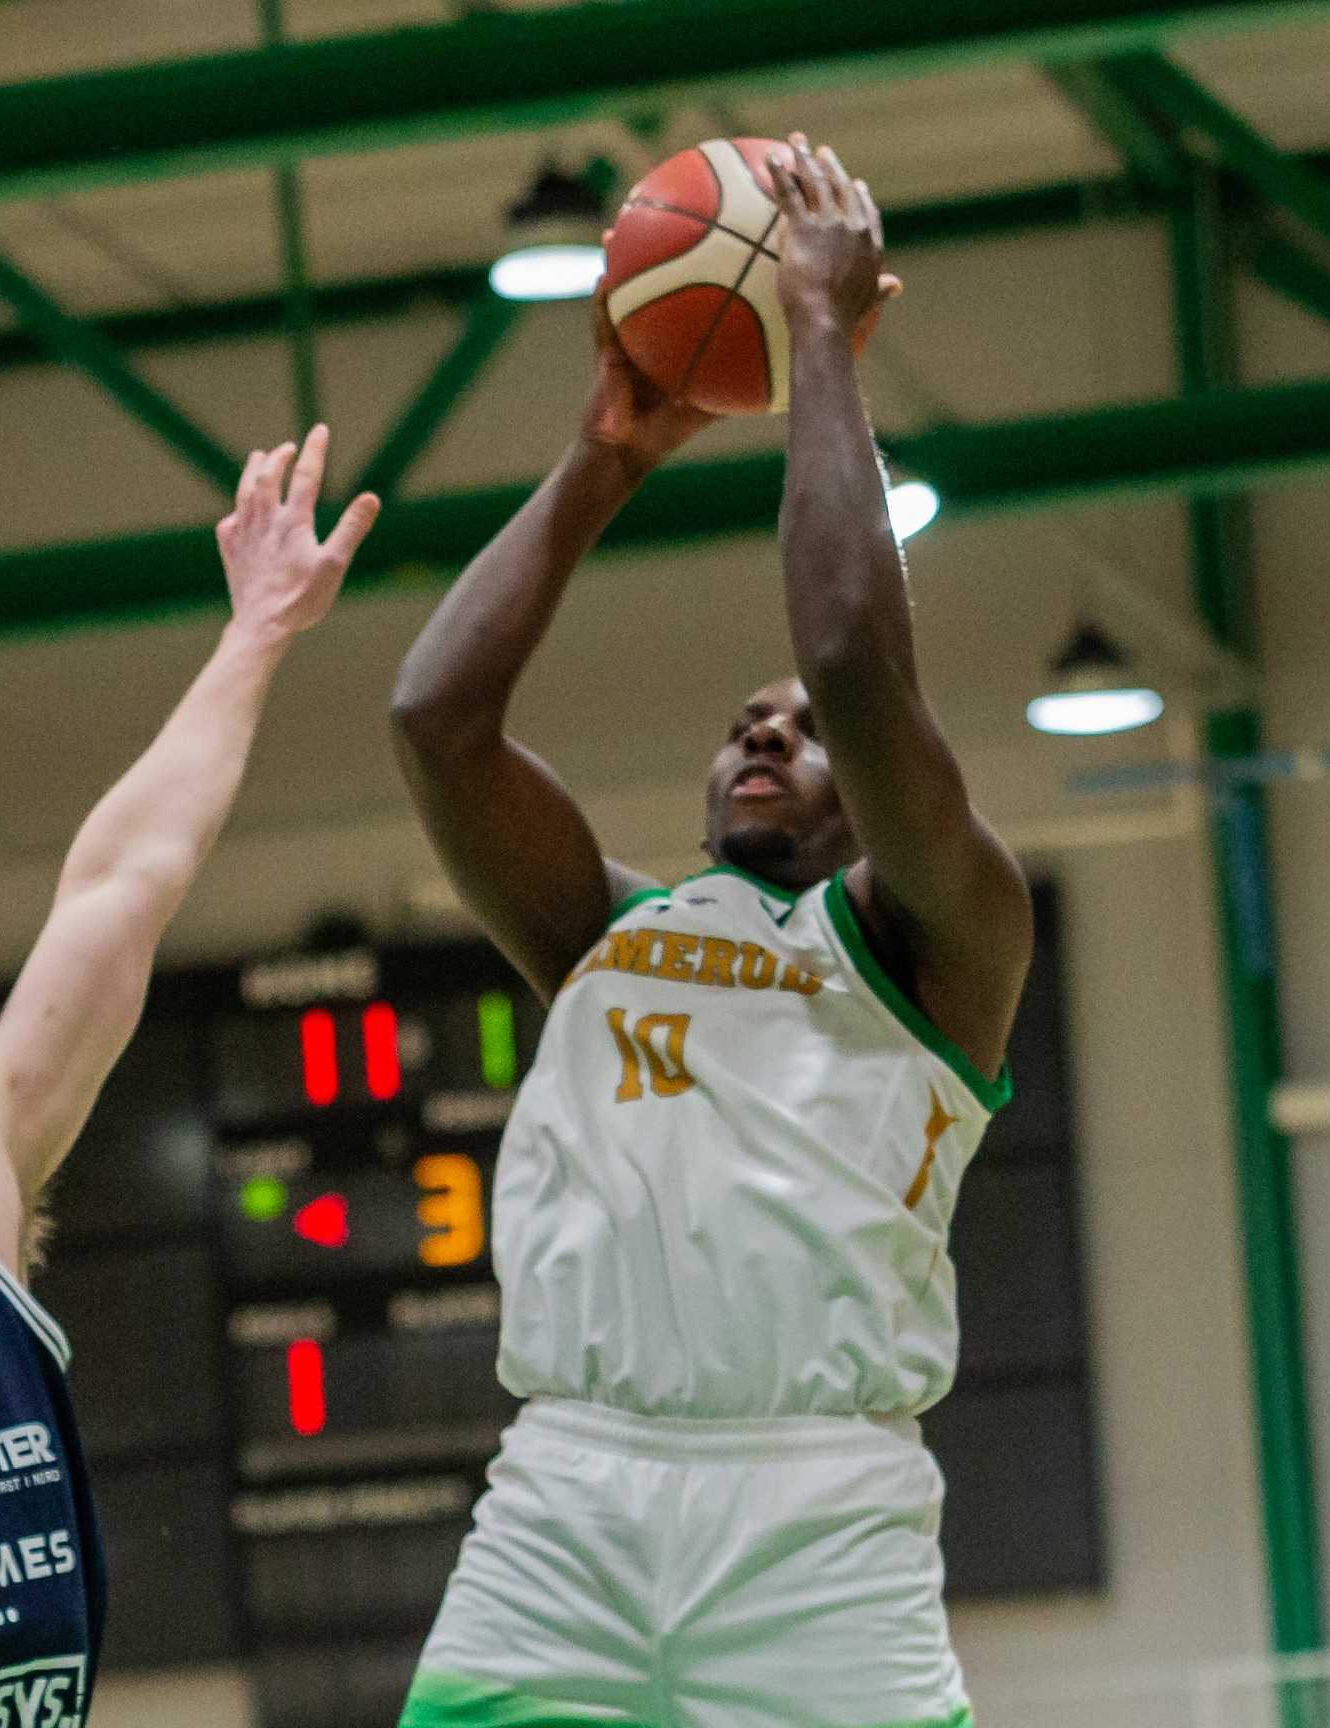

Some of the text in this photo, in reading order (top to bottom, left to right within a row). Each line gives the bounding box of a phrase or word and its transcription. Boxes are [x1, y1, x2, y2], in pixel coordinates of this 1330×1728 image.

[300, 1002, 402, 1107] 11
[606, 1007, 696, 1104] 10
[413, 1153, 484, 1267] 3
[287, 1339, 327, 1437] 1
